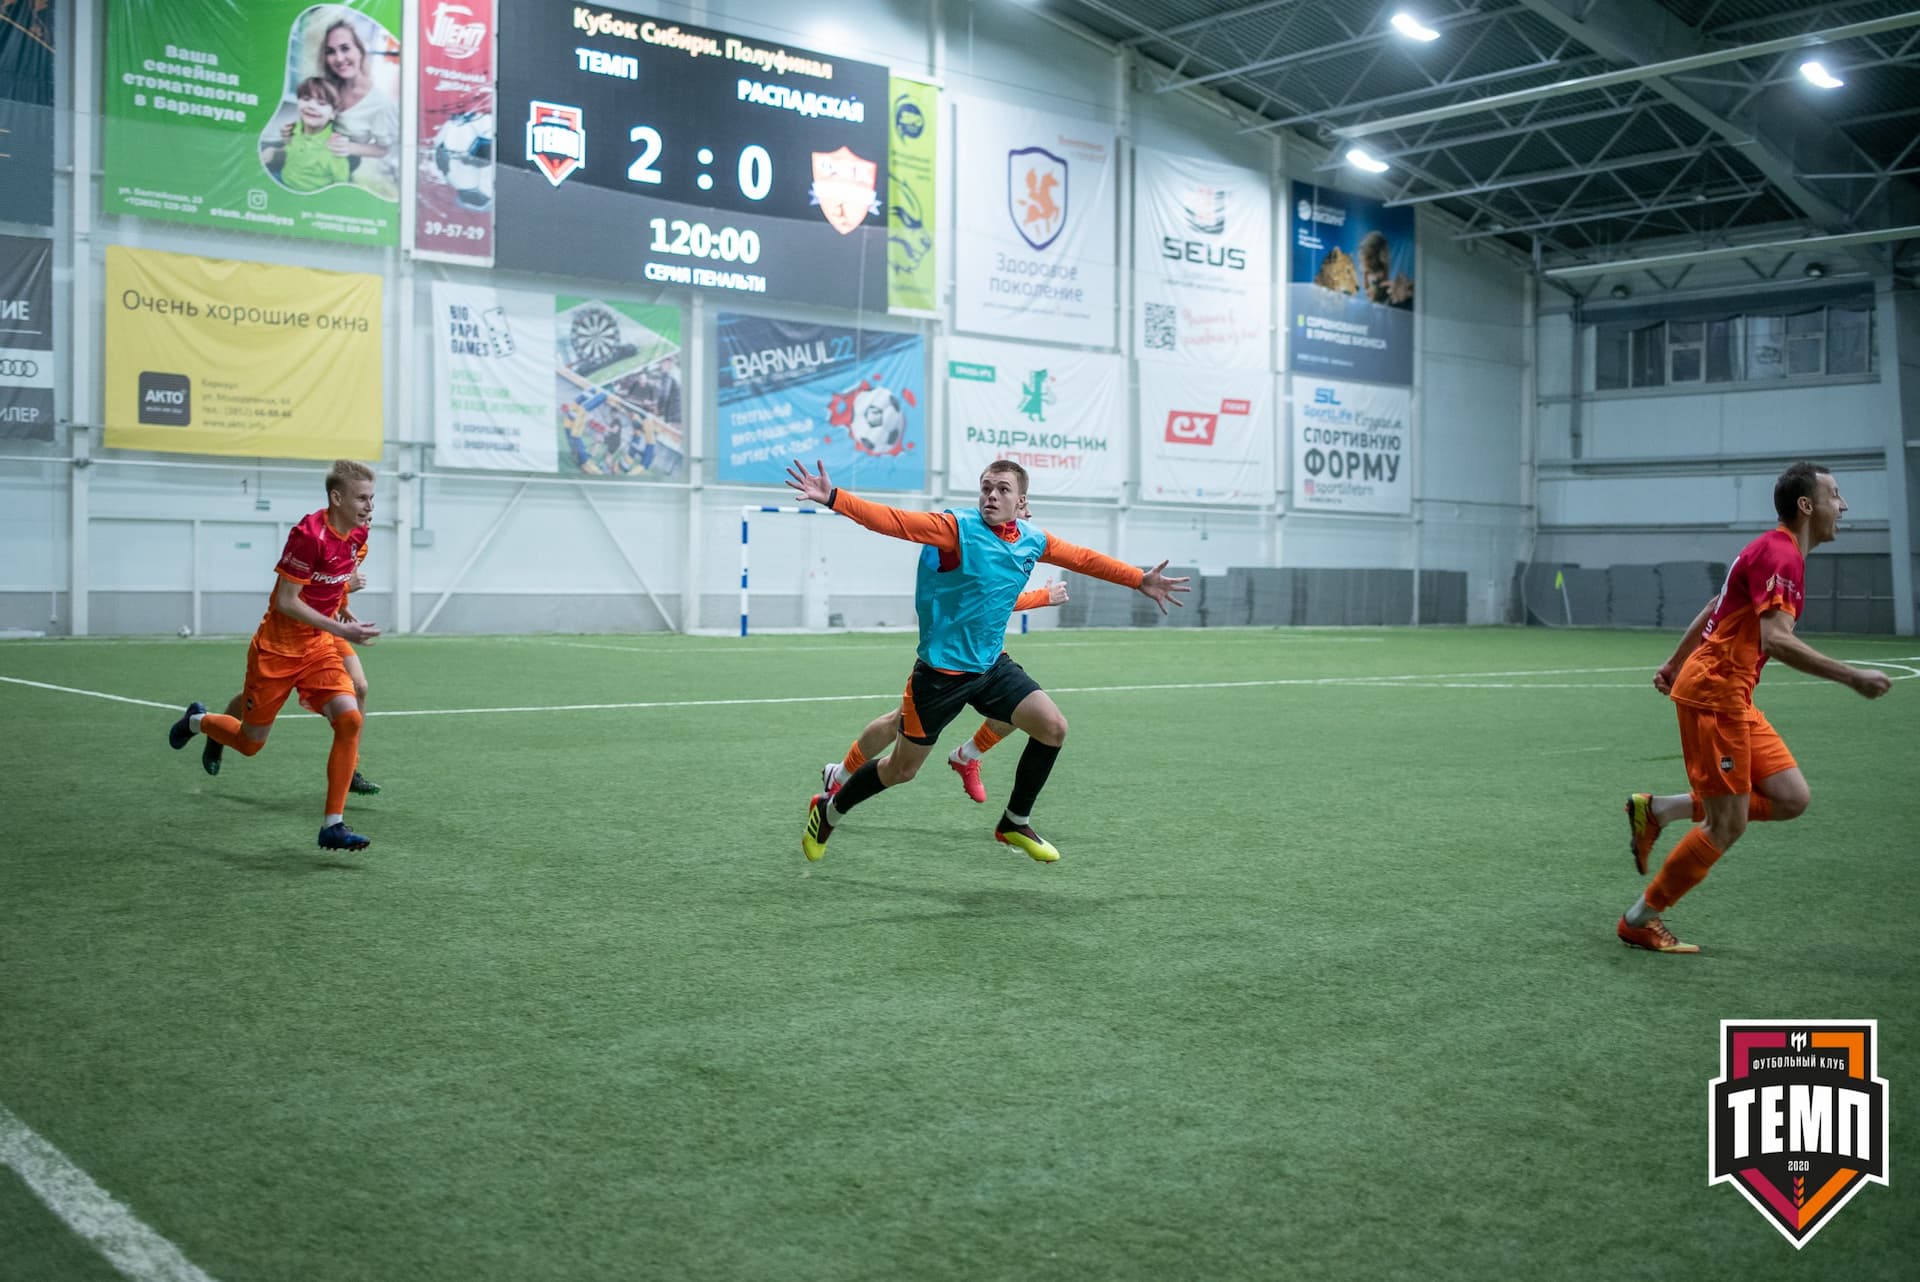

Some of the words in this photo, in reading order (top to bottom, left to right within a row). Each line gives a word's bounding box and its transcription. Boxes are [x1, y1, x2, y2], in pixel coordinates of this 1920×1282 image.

[166, 45, 219, 66] Ваша
[574, 7, 638, 41] Кубок
[639, 22, 722, 58] Сибири.
[725, 38, 833, 80] Полуфинал
[144, 59, 241, 87] семейная
[575, 47, 639, 80] ТЕМП
[123, 72, 260, 106] стоматология
[135, 94, 147, 107] в
[737, 79, 865, 123] РАСПАДСКАЯ
[627, 126, 662, 185] 2
[738, 144, 773, 201] 0
[424, 221, 486, 241] 39-57-29
[649, 217, 760, 264] 120:00
[996, 252, 1079, 281] Здоровое
[1162, 235, 1247, 271] SEUS
[644, 263, 692, 286] СЕРИЯ
[693, 267, 767, 293] ПЕНАЛЬТИ
[990, 274, 1084, 303] поколение
[0, 299, 30, 321] ИЕ
[122, 289, 199, 318] Очень
[206, 302, 309, 329] хорошие
[317, 313, 369, 333] окна
[450, 322, 480, 338] PAPA
[1314, 387, 1342, 405] SL
[967, 427, 1107, 456] РАЗДРАКОНИМ
[1303, 427, 1401, 451] СПОРТИВНУЮ
[1304, 447, 1401, 483] ФОРМУ
